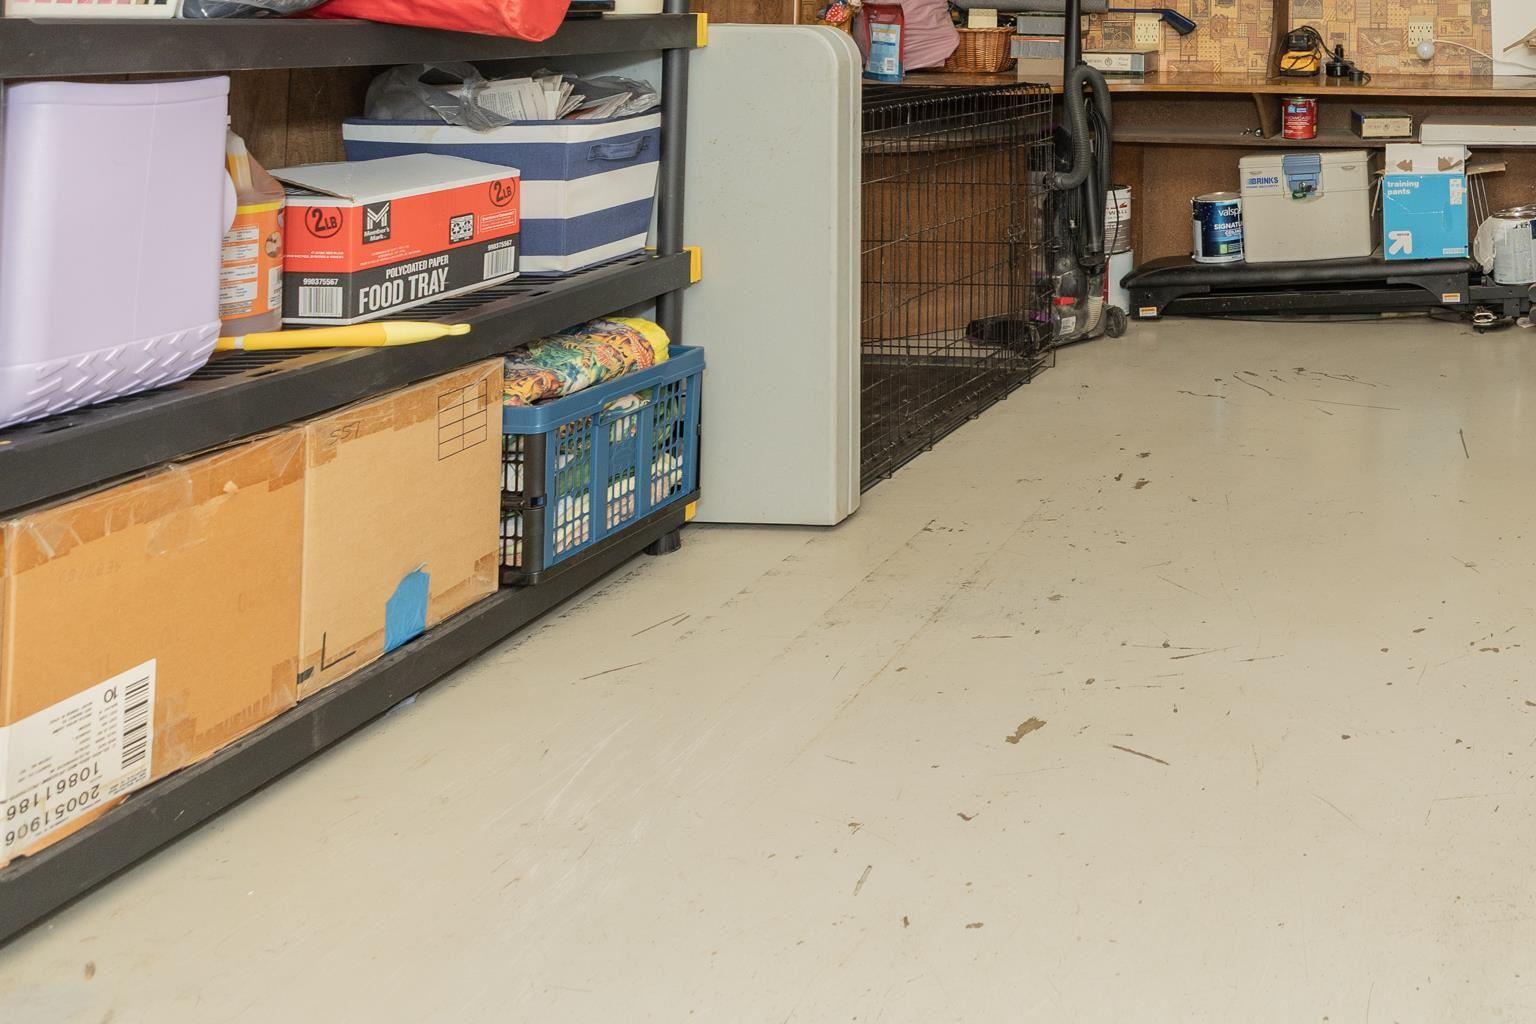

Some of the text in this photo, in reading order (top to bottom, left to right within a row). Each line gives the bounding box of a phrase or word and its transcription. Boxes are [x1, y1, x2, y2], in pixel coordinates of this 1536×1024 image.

[1387, 179, 1420, 189] training
[1387, 188, 1411, 196] pants
[385, 258, 428, 279] POLYCOATED
[428, 254, 449, 269] PAPER
[358, 266, 449, 315] FOOD TRAY
